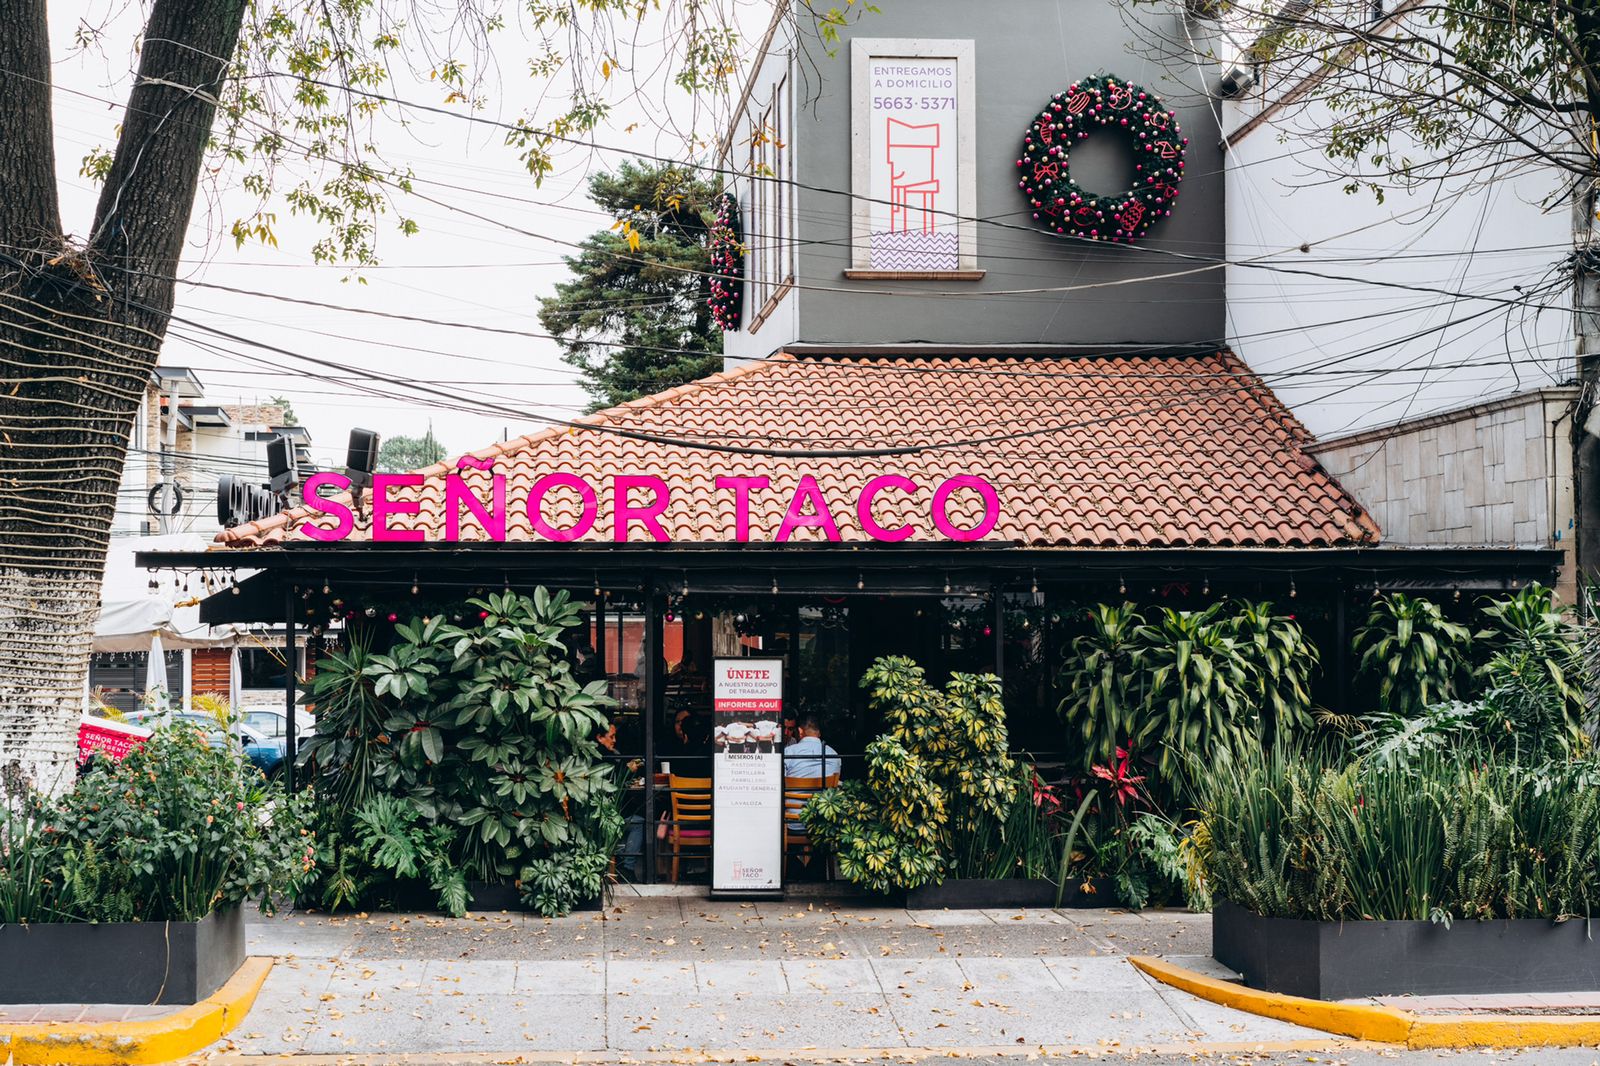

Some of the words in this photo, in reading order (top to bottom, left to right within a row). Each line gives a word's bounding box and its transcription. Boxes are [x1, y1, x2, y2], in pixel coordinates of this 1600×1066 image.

[874, 66, 952, 76] ENTREGAMOS
[874, 79, 882, 88] A
[887, 79, 953, 88] DOMICILIO
[300, 456, 672, 542] SEÑOR
[715, 474, 1000, 542] TACO
[727, 667, 770, 679] ÚNETE
[758, 700, 778, 708] AQUÍ
[85, 732, 113, 745] SEÑOR
[114, 740, 134, 750] TACO
